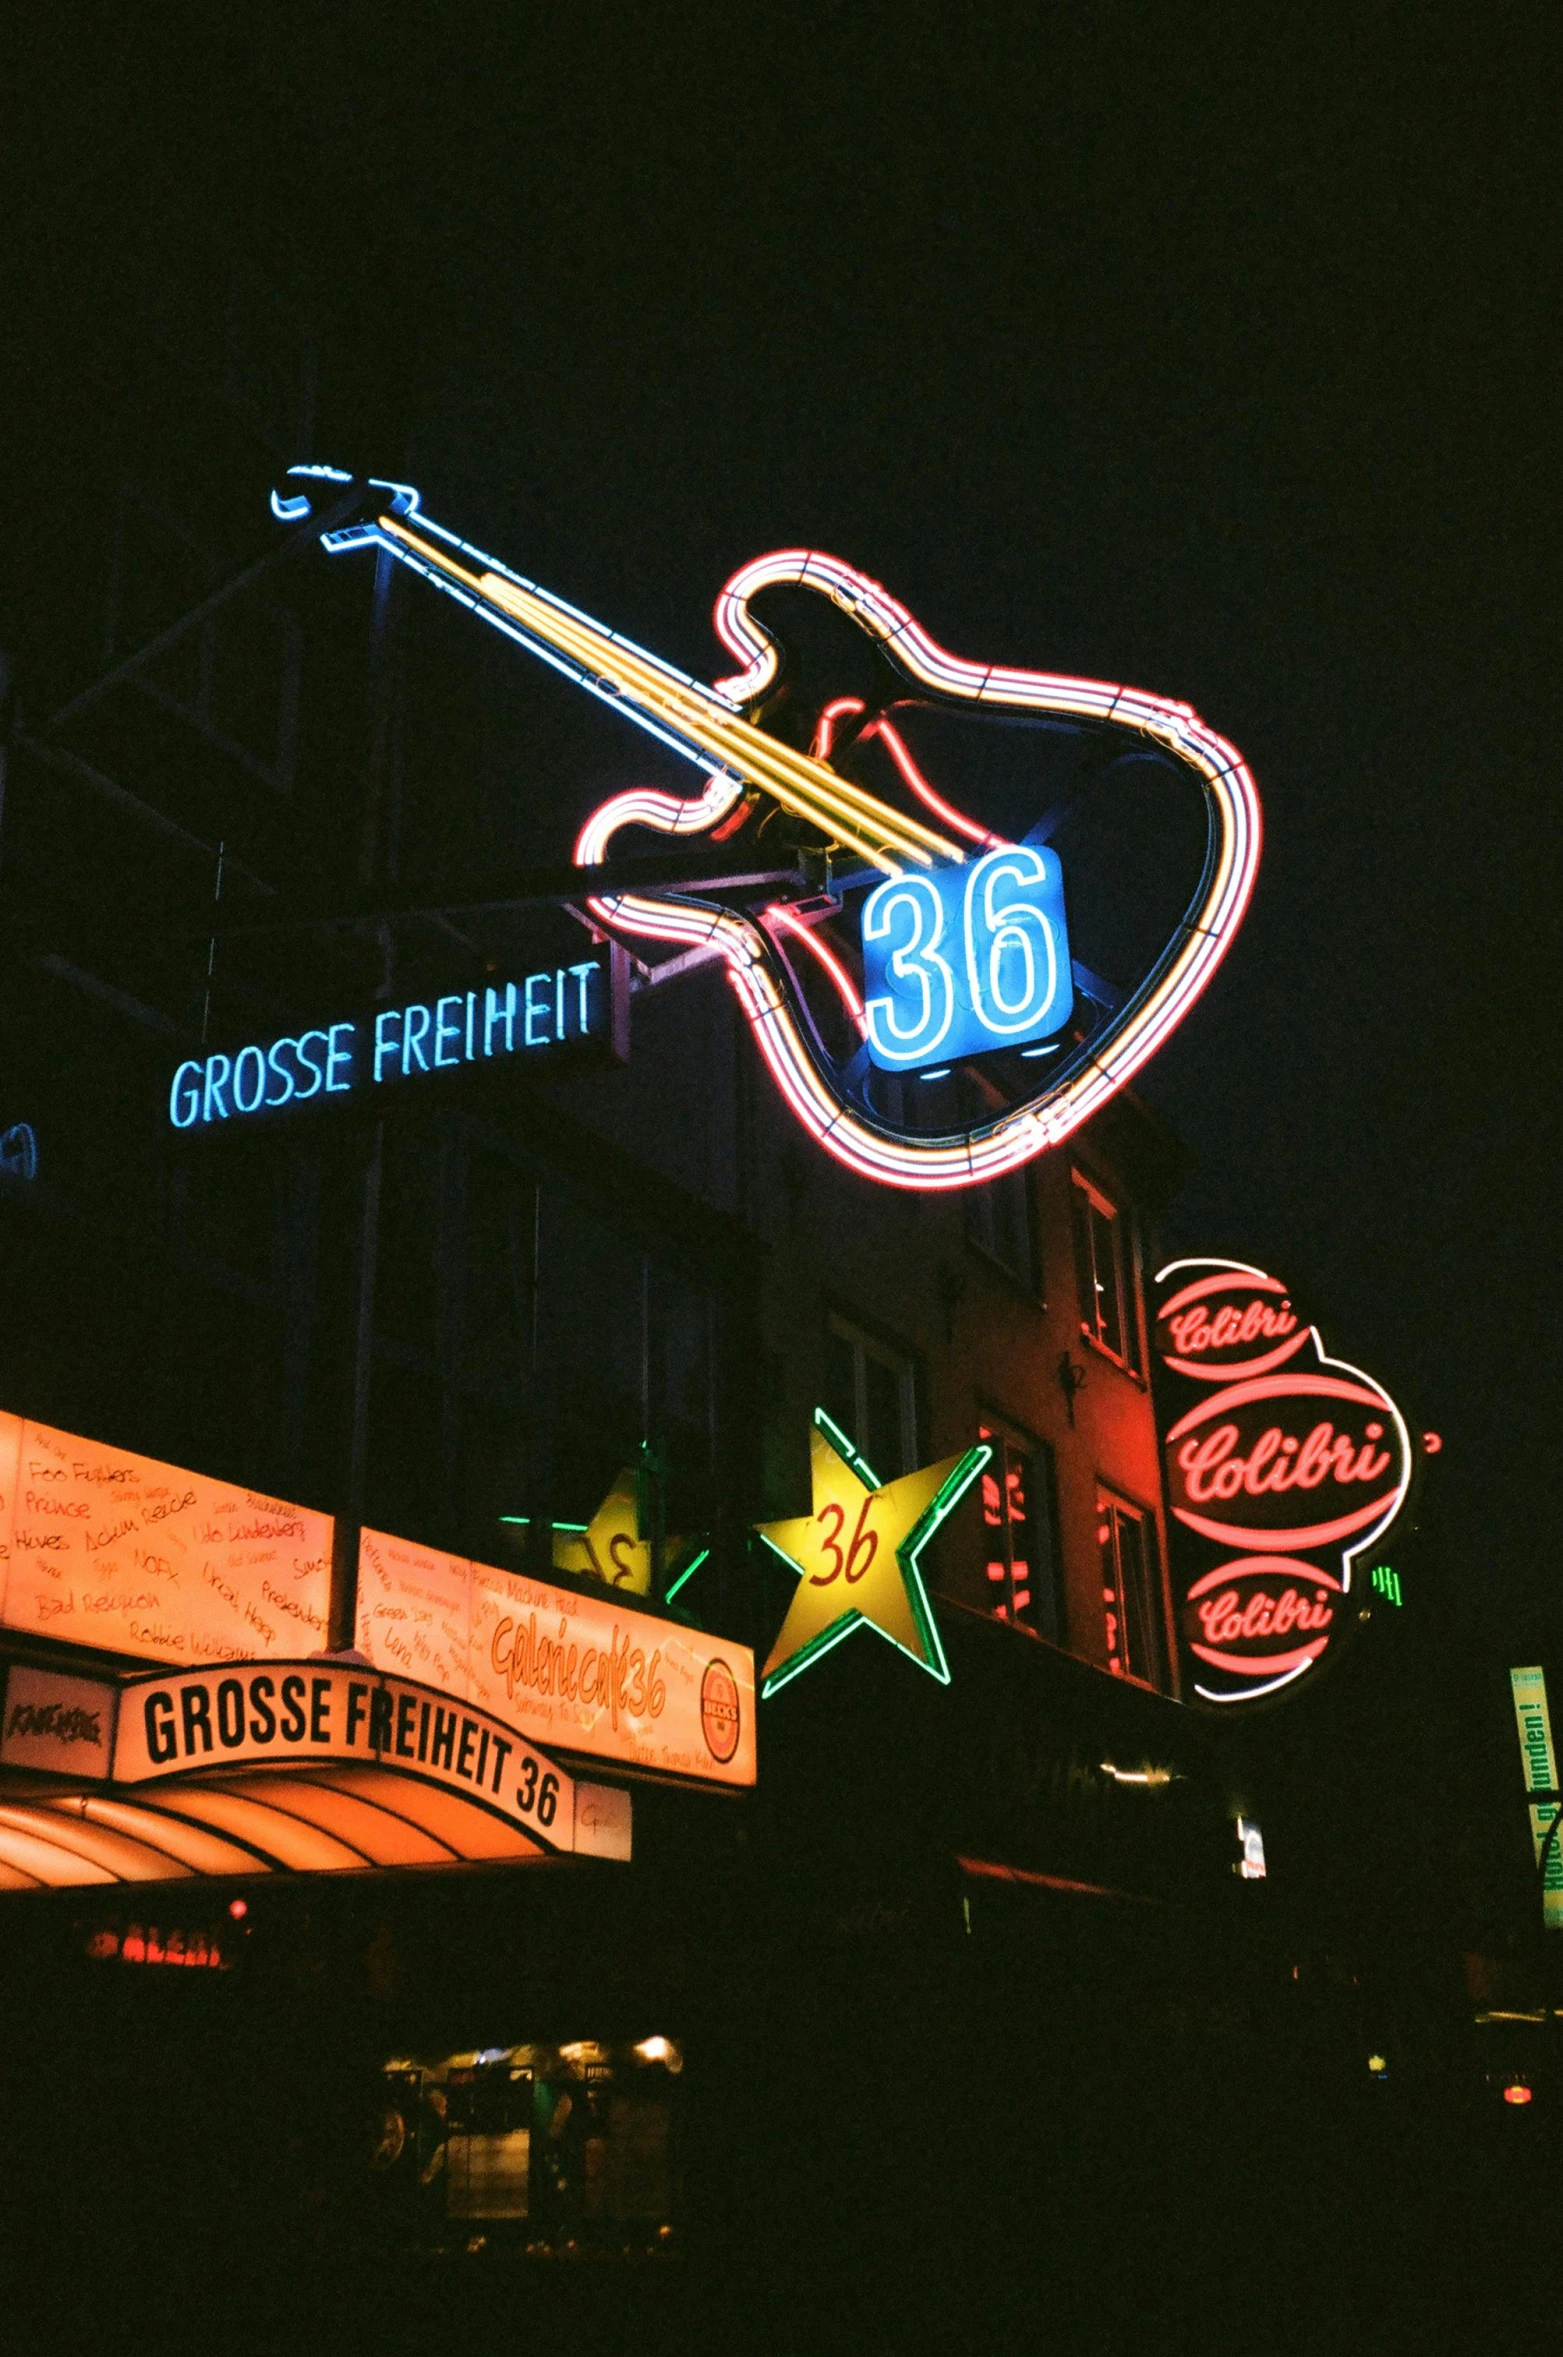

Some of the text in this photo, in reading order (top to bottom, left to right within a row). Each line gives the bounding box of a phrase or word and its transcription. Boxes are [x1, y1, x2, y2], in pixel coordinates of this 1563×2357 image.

[863, 845, 1057, 1061] 36
[169, 961, 601, 1128] GROSSE FREIHEIT
[1170, 1300, 1297, 1353] Colibri
[28, 1462, 67, 1484] Foo
[1179, 1422, 1390, 1502] Colibri
[25, 1490, 92, 1520] Prince
[15, 1529, 70, 1552] Hives
[808, 1494, 878, 1587] 36
[35, 1589, 74, 1622] Bad
[1199, 1590, 1333, 1643] Colibri
[130, 1622, 185, 1651] Robbie
[385, 1626, 414, 1670] Lena
[144, 1675, 332, 1764] GROSSE
[346, 1681, 513, 1795] FREIHEIT
[516, 1756, 561, 1828] 36
